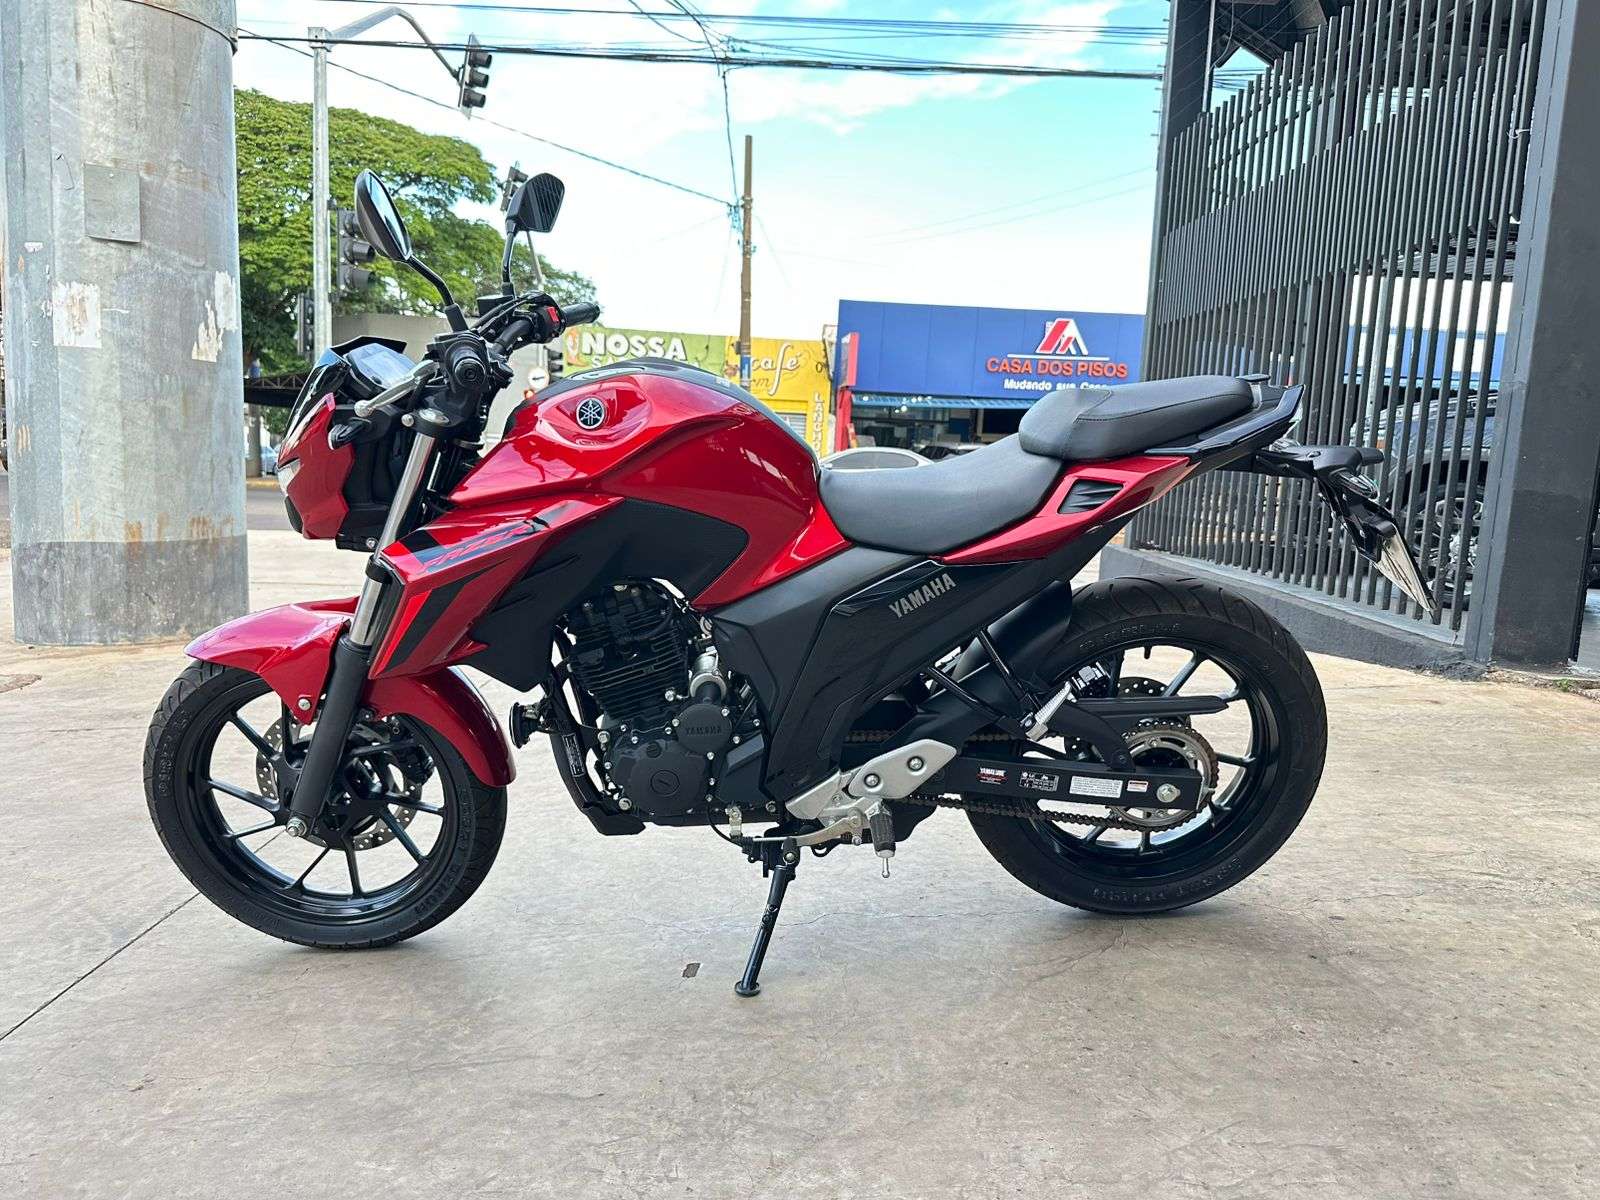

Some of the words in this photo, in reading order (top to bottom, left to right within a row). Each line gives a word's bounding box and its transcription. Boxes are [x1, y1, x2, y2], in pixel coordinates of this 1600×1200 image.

[582, 332, 687, 361] NOSSA
[986, 357, 1033, 374] CASA
[1037, 359, 1073, 376] DOS
[1077, 361, 1128, 378] PISOS
[1004, 378, 1052, 391] Mudando
[888, 573, 957, 618] YAMAHA
